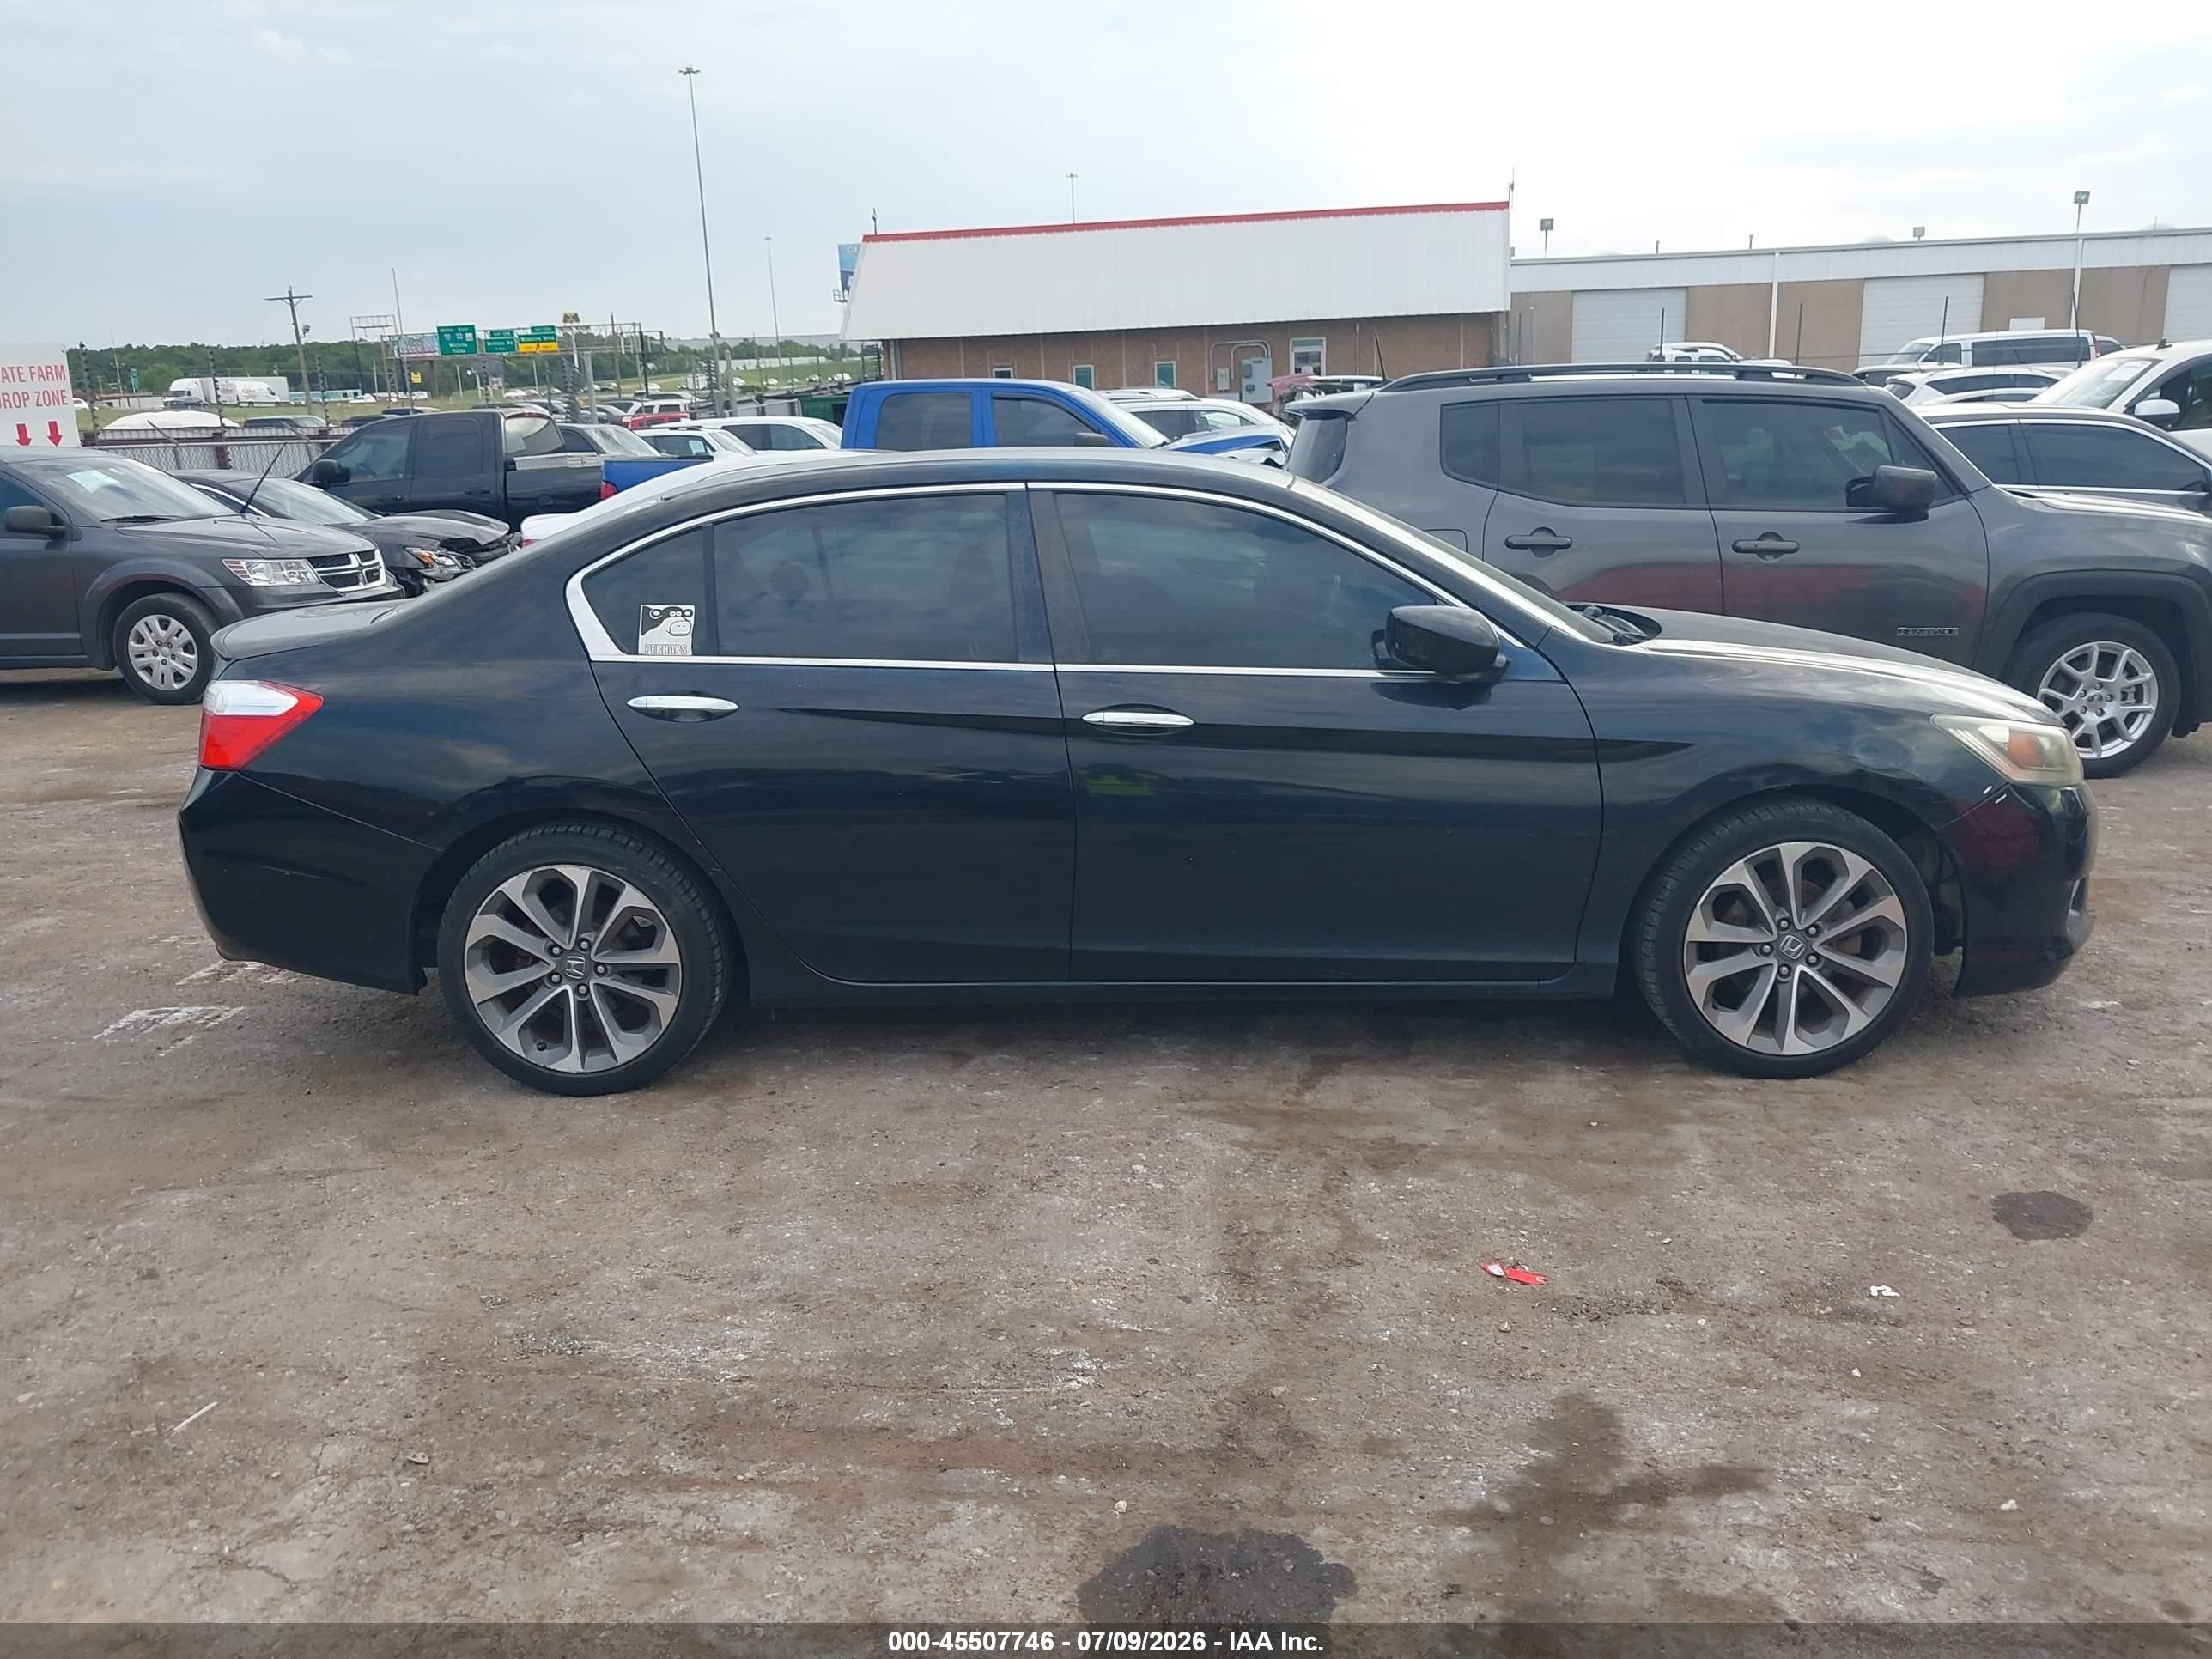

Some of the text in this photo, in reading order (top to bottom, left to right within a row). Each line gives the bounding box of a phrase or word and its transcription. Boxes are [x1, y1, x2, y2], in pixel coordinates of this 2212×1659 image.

[28, 364, 66, 382] FARM
[0, 389, 69, 409] ROP ZONE
[645, 643, 688, 655] PERHAPS
